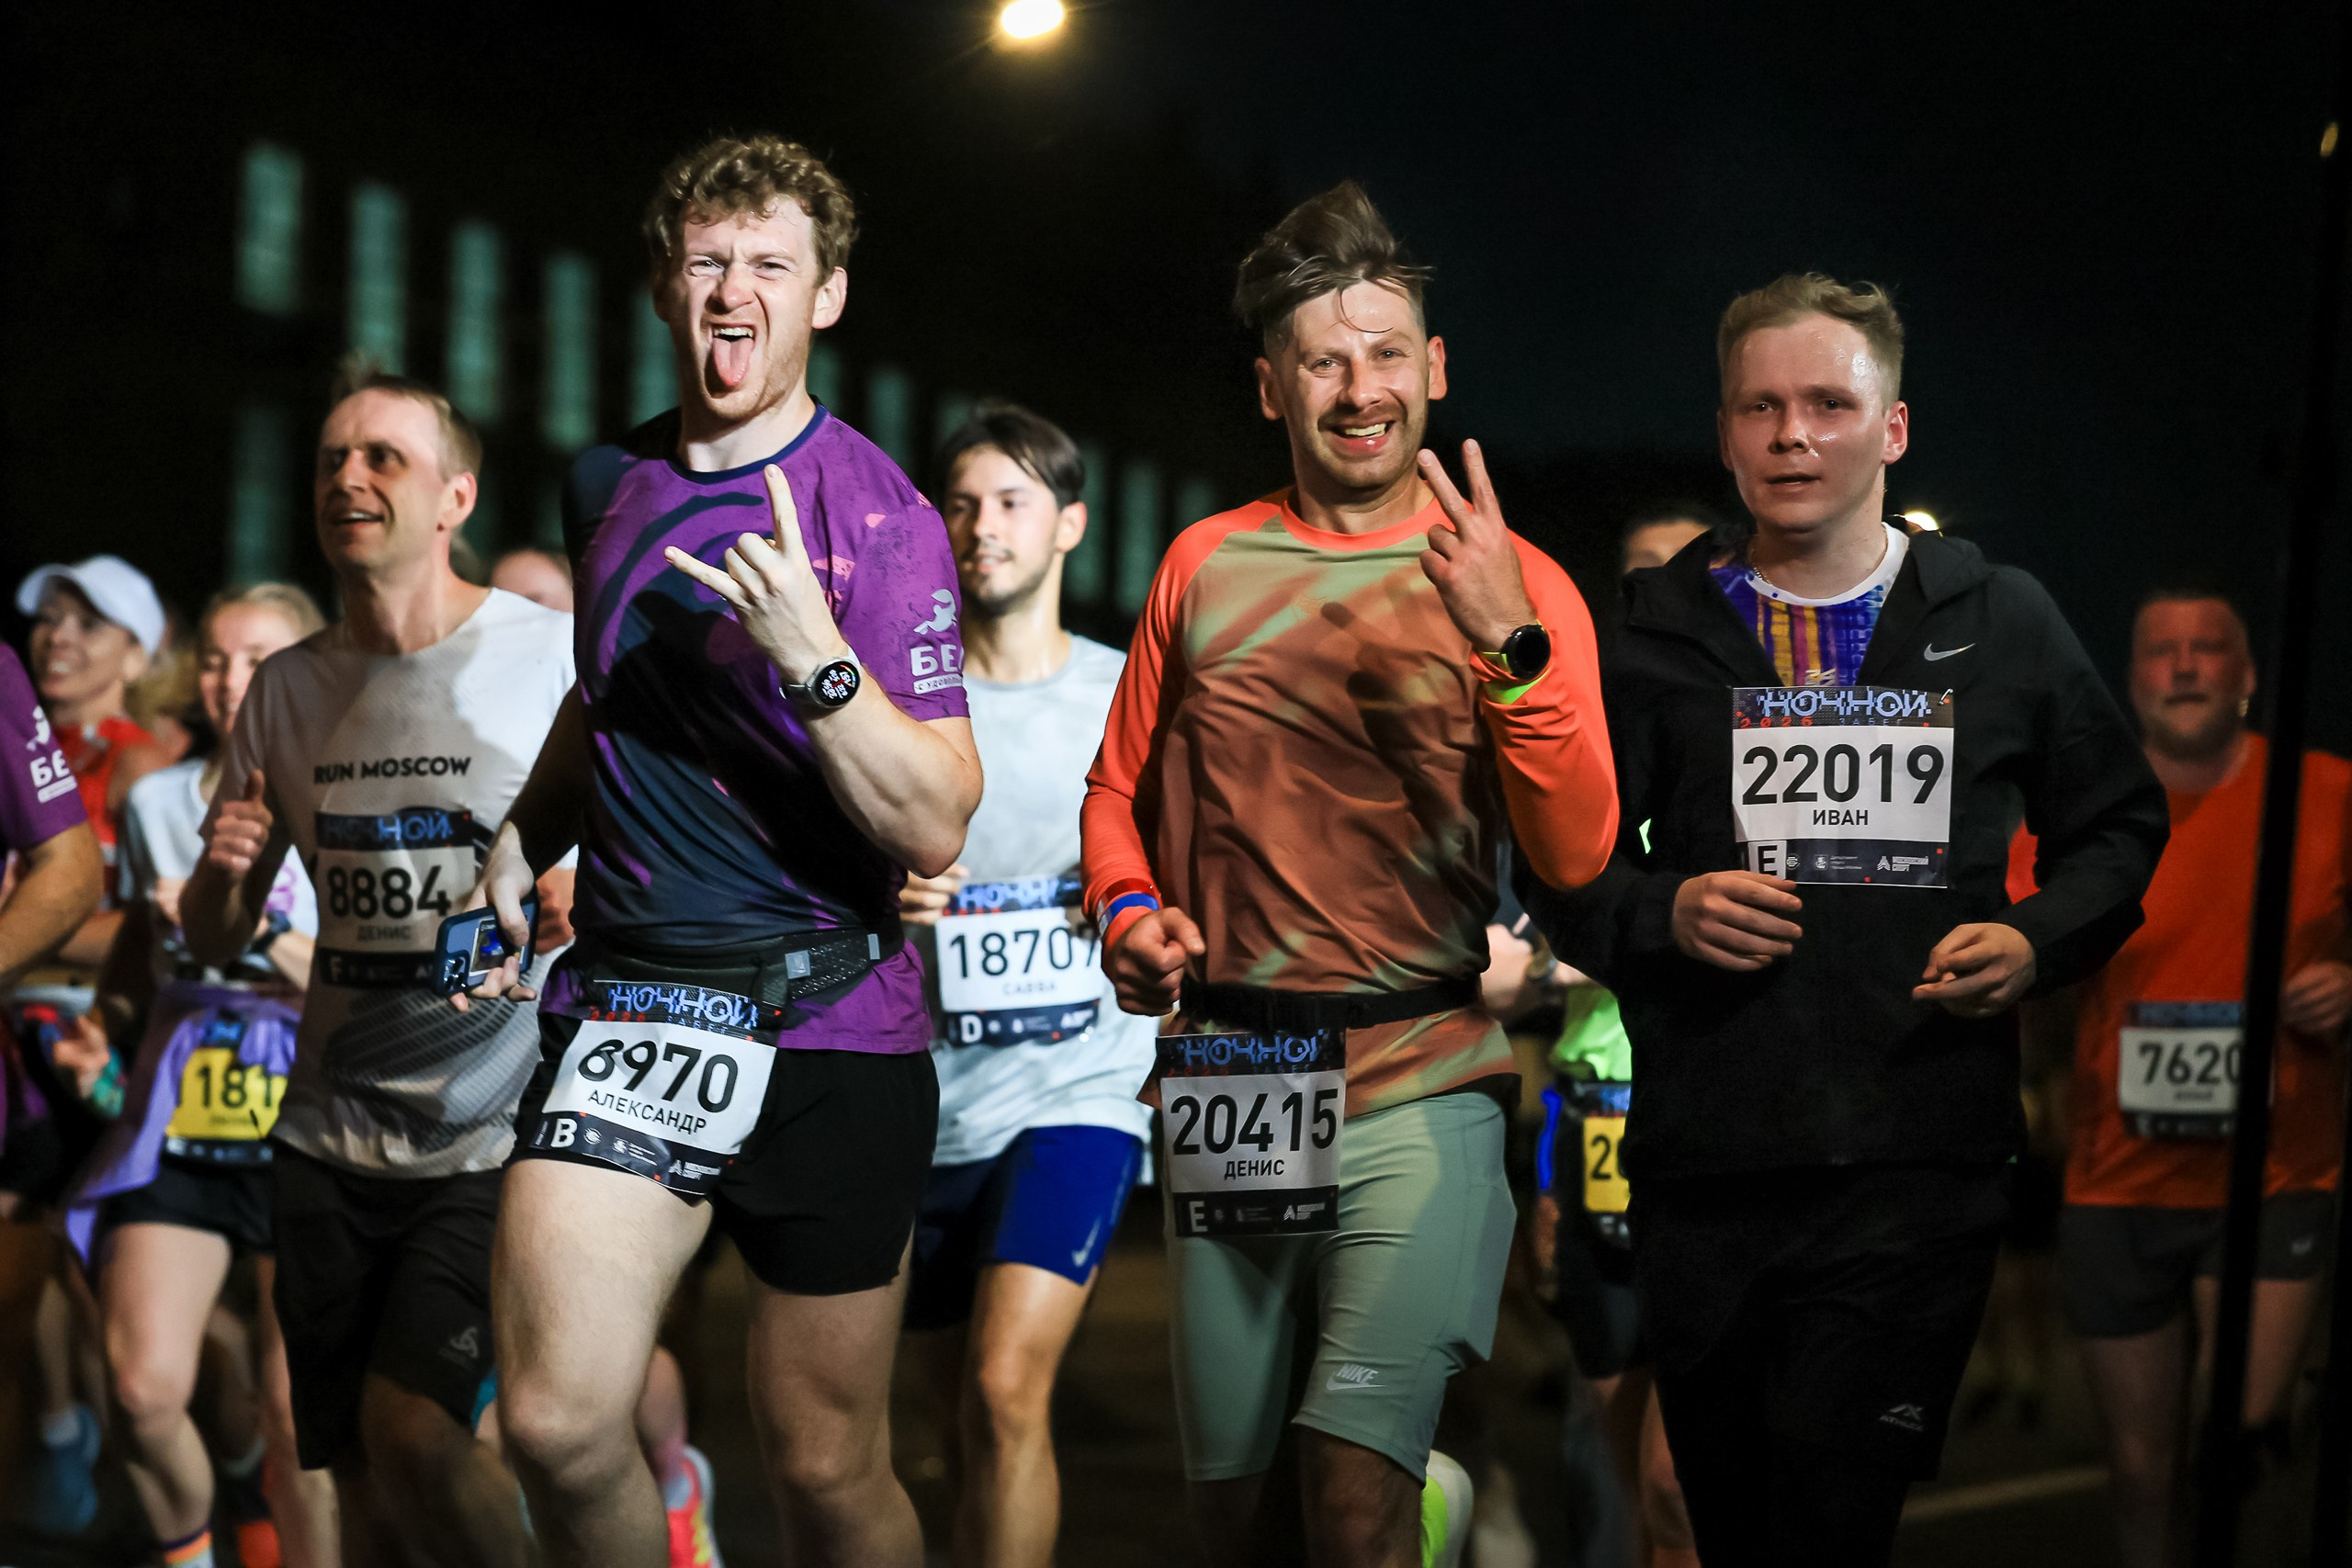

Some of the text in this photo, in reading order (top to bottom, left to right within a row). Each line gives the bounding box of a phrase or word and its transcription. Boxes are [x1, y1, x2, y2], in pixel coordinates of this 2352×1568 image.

[1757, 687, 1931, 717] НОЧНОЙ
[314, 756, 471, 784] RUN MOSCOW
[1742, 743, 1944, 805] 22019
[1813, 809, 1869, 826] ИВАН
[327, 864, 452, 919] 8884
[608, 983, 758, 1030] НОЧНОЙ
[960, 1014, 983, 1043] D
[588, 1089, 707, 1135] АЛЕКСАНДР
[1170, 1088, 1339, 1156] 20415
[551, 1118, 577, 1148] B
[1224, 1159, 1285, 1181] ДЕНИС
[1189, 1201, 1208, 1233] E
[1337, 1362, 1378, 1385] NIKE
